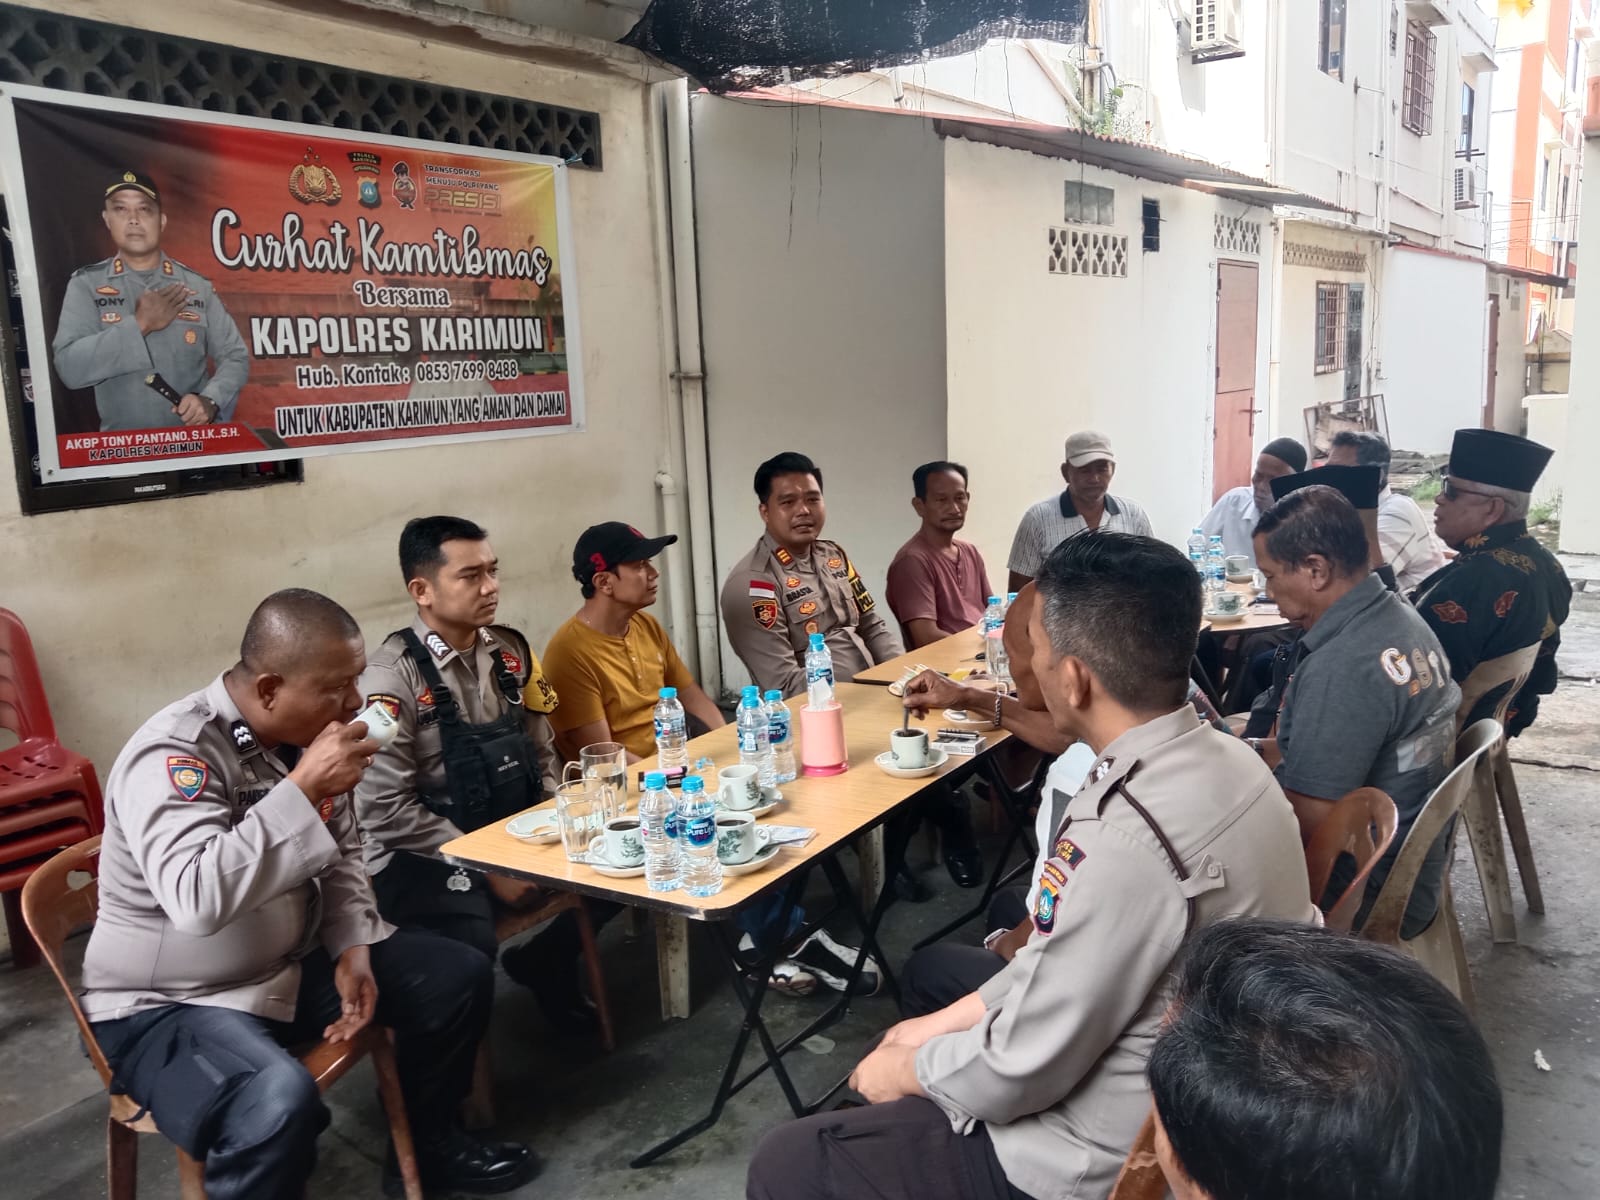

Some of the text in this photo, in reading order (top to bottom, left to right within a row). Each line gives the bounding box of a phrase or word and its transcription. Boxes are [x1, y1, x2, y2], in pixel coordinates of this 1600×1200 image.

[425, 164, 481, 177] TRANSFORMASI
[426, 177, 457, 187] MENUJU
[424, 189, 500, 209] PRESISI
[212, 208, 552, 286] Curhat Kamtibmas
[354, 281, 452, 308] Bersama
[250, 316, 543, 356] KAPOLRES KARIMUN
[298, 366, 340, 387] Hub.
[416, 363, 450, 382] 0853
[453, 361, 484, 380] 7699
[487, 360, 518, 380] 8488
[276, 391, 566, 437] UNTUK KABUPATEN KARIMUN YANG AMAN DAN DAMAI
[65, 437, 100, 451] AKBP
[101, 435, 132, 447] TONY
[89, 442, 203, 461] KAPOLRES KARIMUN
